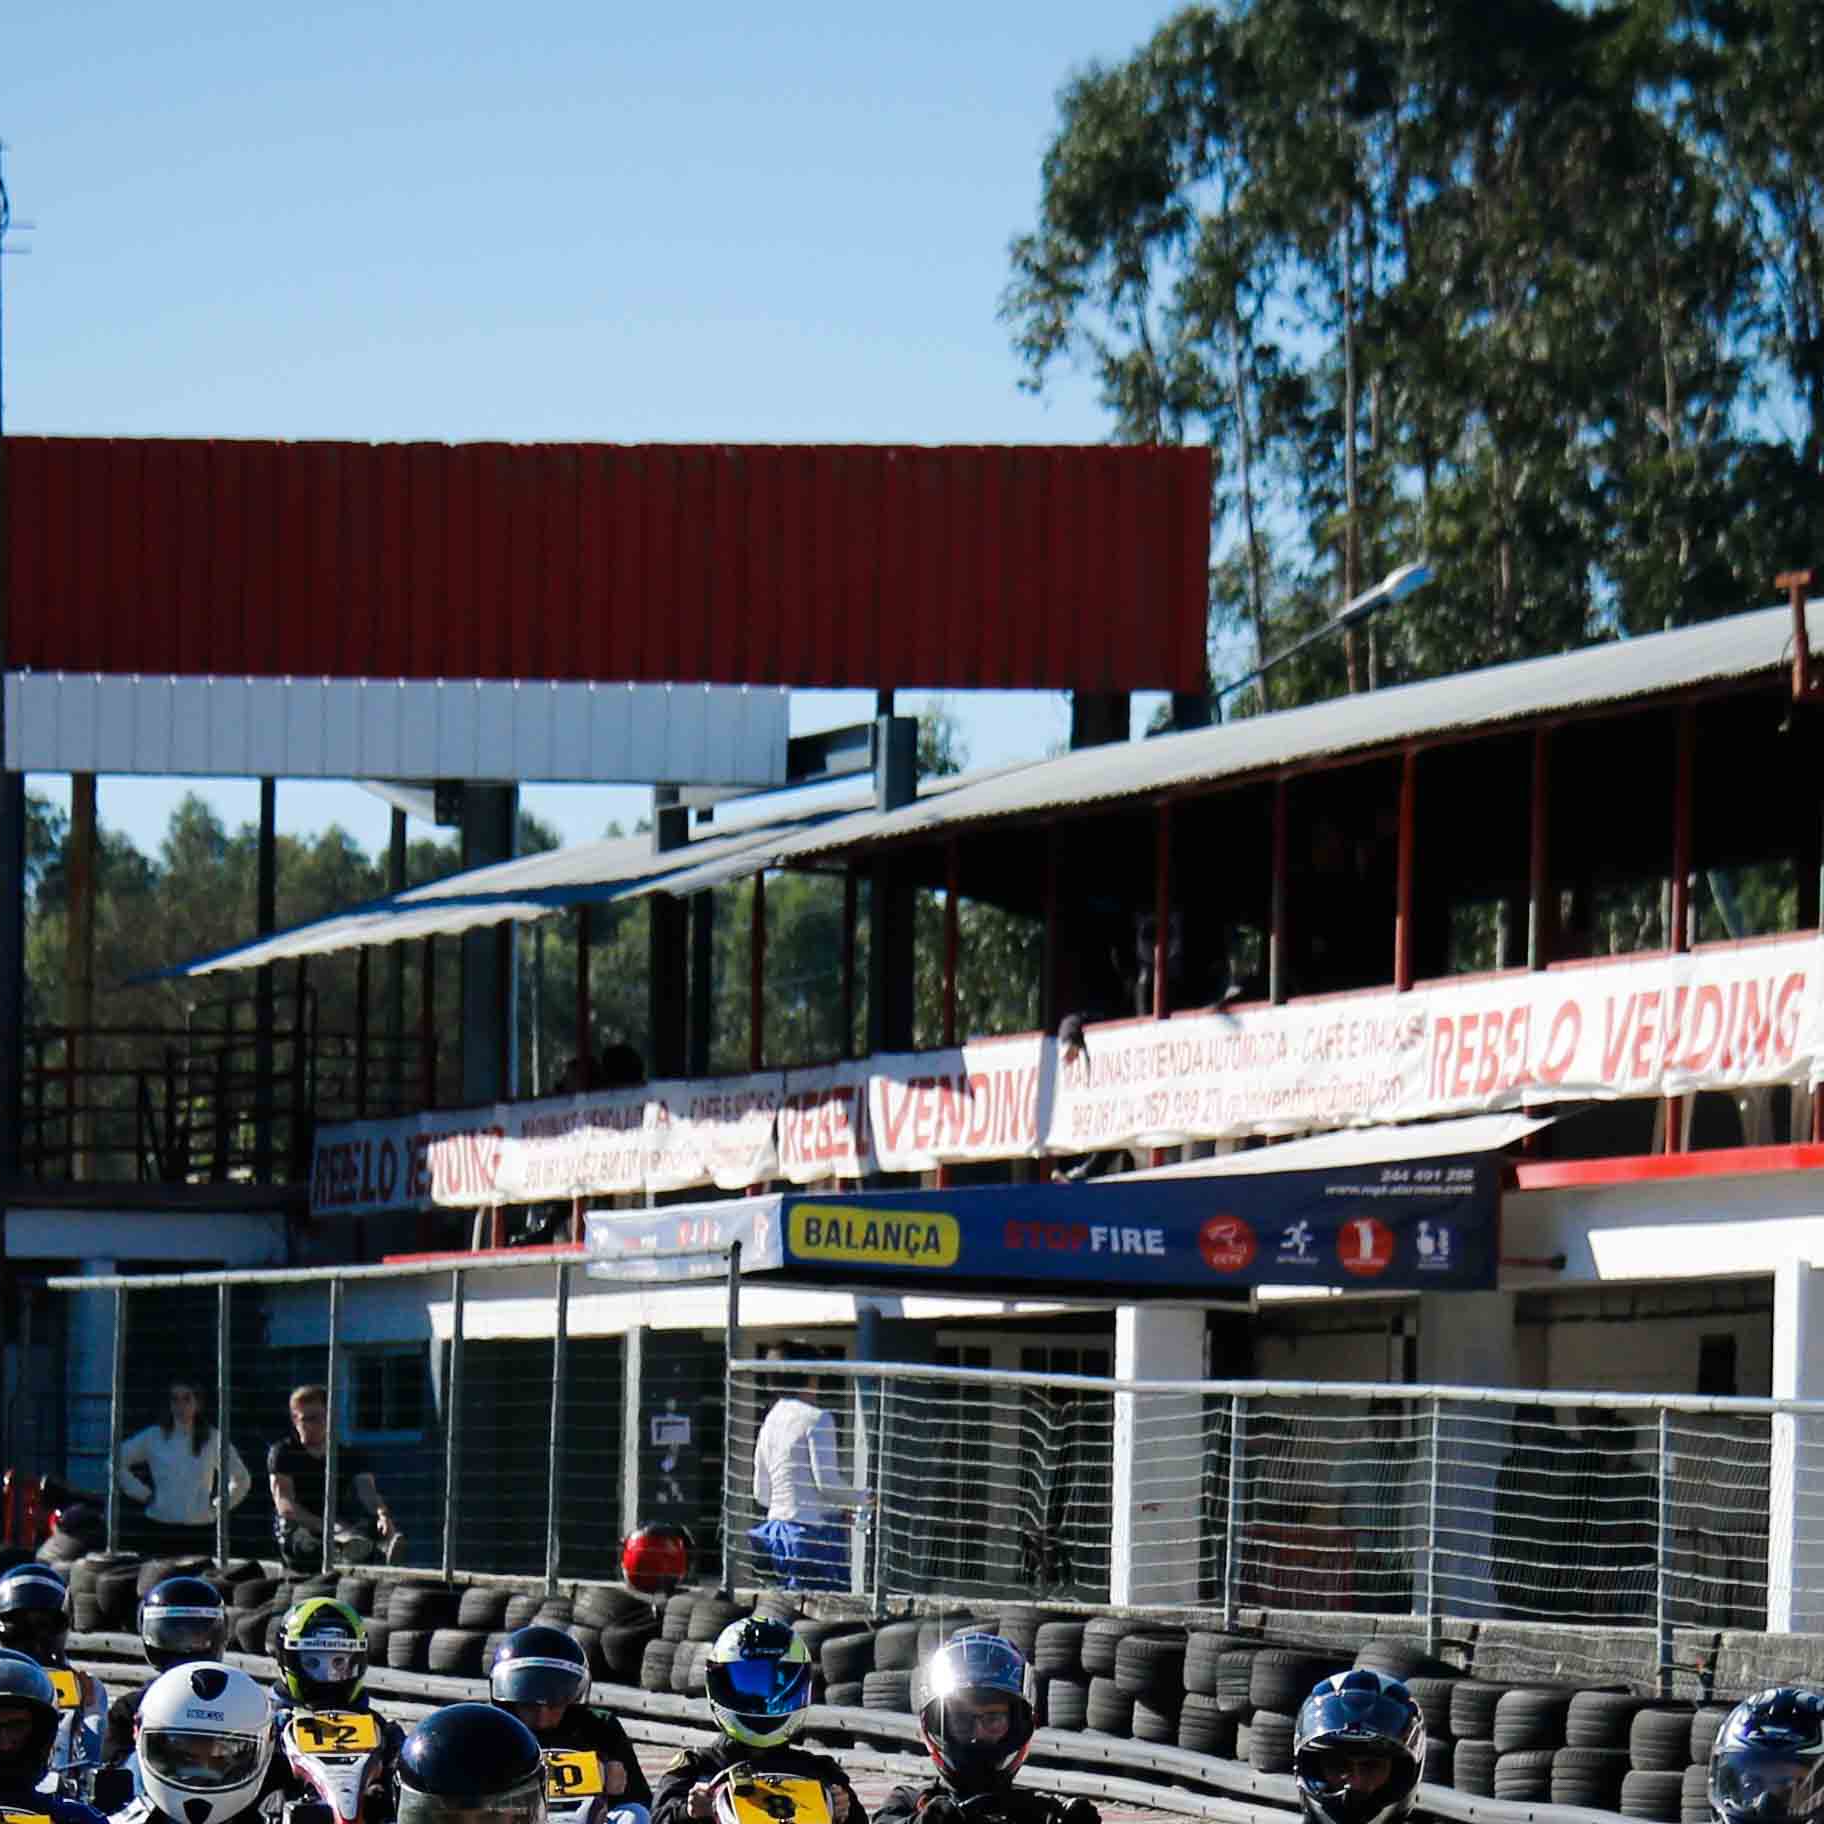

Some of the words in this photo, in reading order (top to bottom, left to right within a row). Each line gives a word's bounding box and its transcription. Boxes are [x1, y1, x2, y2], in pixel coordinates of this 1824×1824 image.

[1428, 998, 1584, 1101] REBELO
[1600, 971, 1807, 1083] VENDING
[804, 1216, 941, 1259] BALANÇA
[303, 1725, 360, 1746] 12
